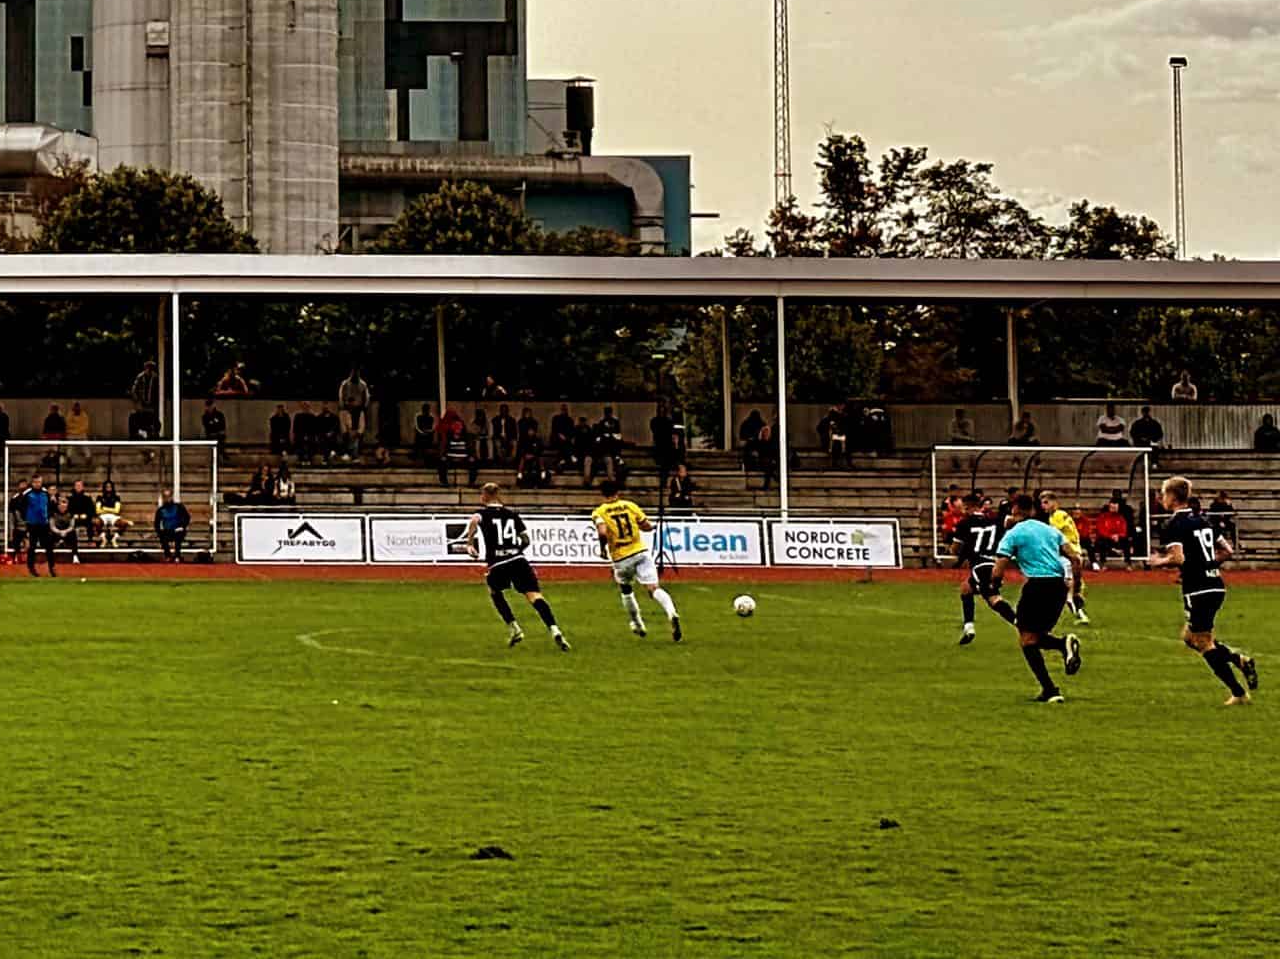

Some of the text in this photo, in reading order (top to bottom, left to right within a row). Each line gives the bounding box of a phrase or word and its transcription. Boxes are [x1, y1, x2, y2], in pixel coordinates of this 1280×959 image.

[386, 535, 443, 546] Nordtrend
[492, 518, 516, 545] 14
[531, 529, 578, 541] INFRA
[656, 526, 748, 552] Clean
[785, 531, 847, 544] NORDIC
[970, 525, 996, 552] 77
[786, 546, 870, 560] CONCRETE
[1193, 528, 1215, 561] 19
